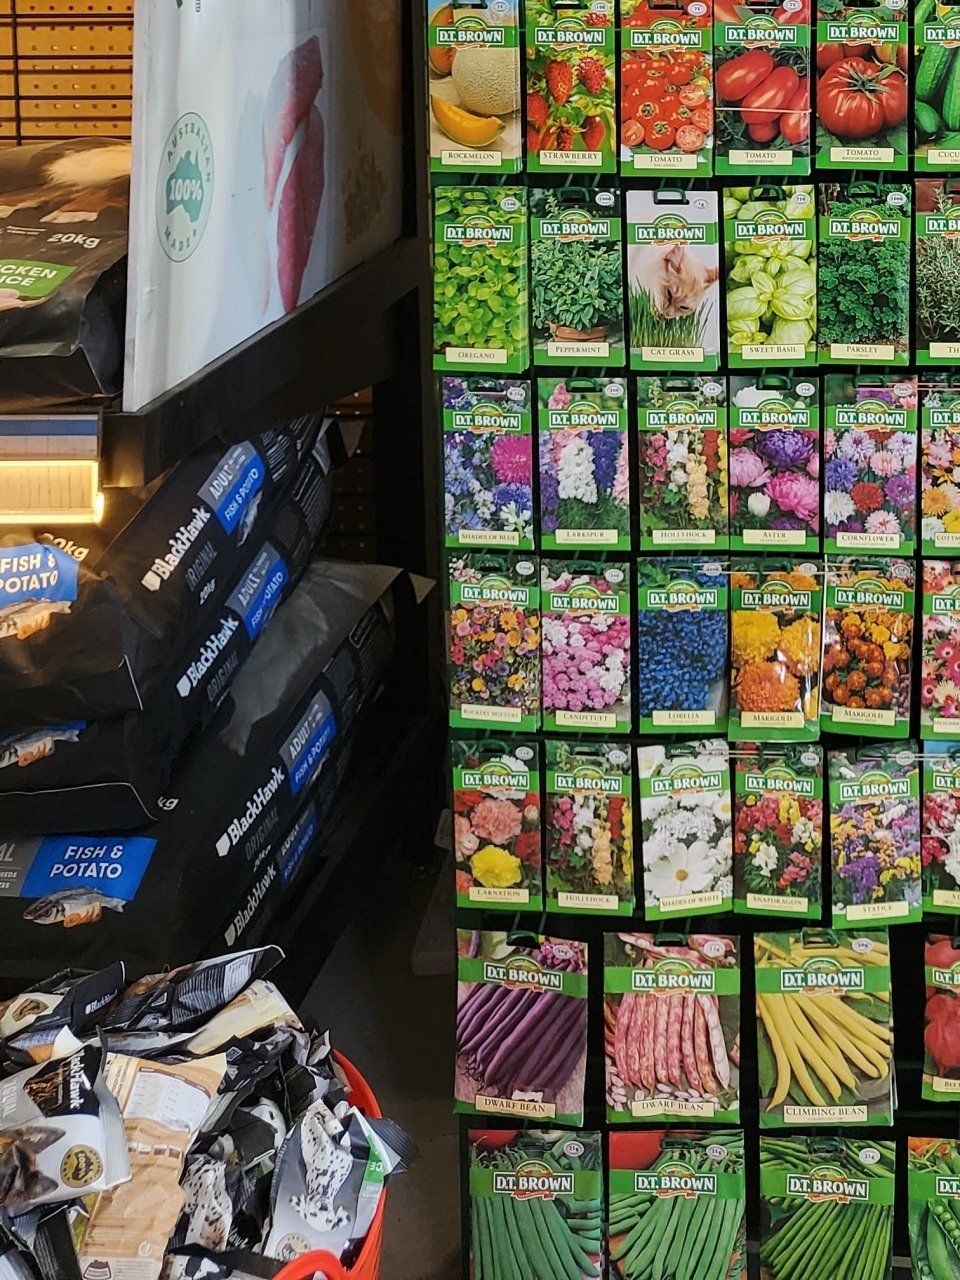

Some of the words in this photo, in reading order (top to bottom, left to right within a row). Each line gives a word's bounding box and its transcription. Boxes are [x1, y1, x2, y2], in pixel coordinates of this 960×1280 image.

[458, 30, 502, 42] BROWN
[448, 152, 494, 160] ROCKMELON
[543, 152, 598, 161] STRAWBERRY
[648, 155, 682, 163] TOMATO
[845, 149, 879, 157] TOMATO
[169, 178, 203, 201] 100%
[657, 227, 703, 239] BROWN
[47, 233, 101, 249] 20kg
[555, 346, 601, 354] PEPPERMINT
[650, 348, 667, 356] CAT
[669, 348, 695, 356] GRASS
[749, 346, 774, 354] SWEET
[846, 345, 878, 353] PARSLEY
[761, 413, 807, 424] BROWN
[208, 462, 234, 502] ADULT
[762, 531, 786, 539] ASTER
[153, 505, 212, 582] BlackHawk
[0, 553, 42, 573] FISH
[669, 592, 715, 605] BROWN
[186, 615, 239, 689] BlackHawk
[752, 714, 792, 722] MARIGOLD
[483, 775, 527, 786] BROWN
[227, 765, 285, 845] BlackHawk
[64, 845, 107, 860] FISH
[110, 845, 123, 859] &
[50, 862, 122, 879] POTATO
[235, 861, 277, 938] BlackHawk
[657, 974, 712, 988] BROWN
[786, 1107, 832, 1117] CLIMBING
[835, 1106, 865, 1117] BEAN
[518, 1176, 571, 1189] BROWN
[812, 1178, 867, 1191] BROWN
